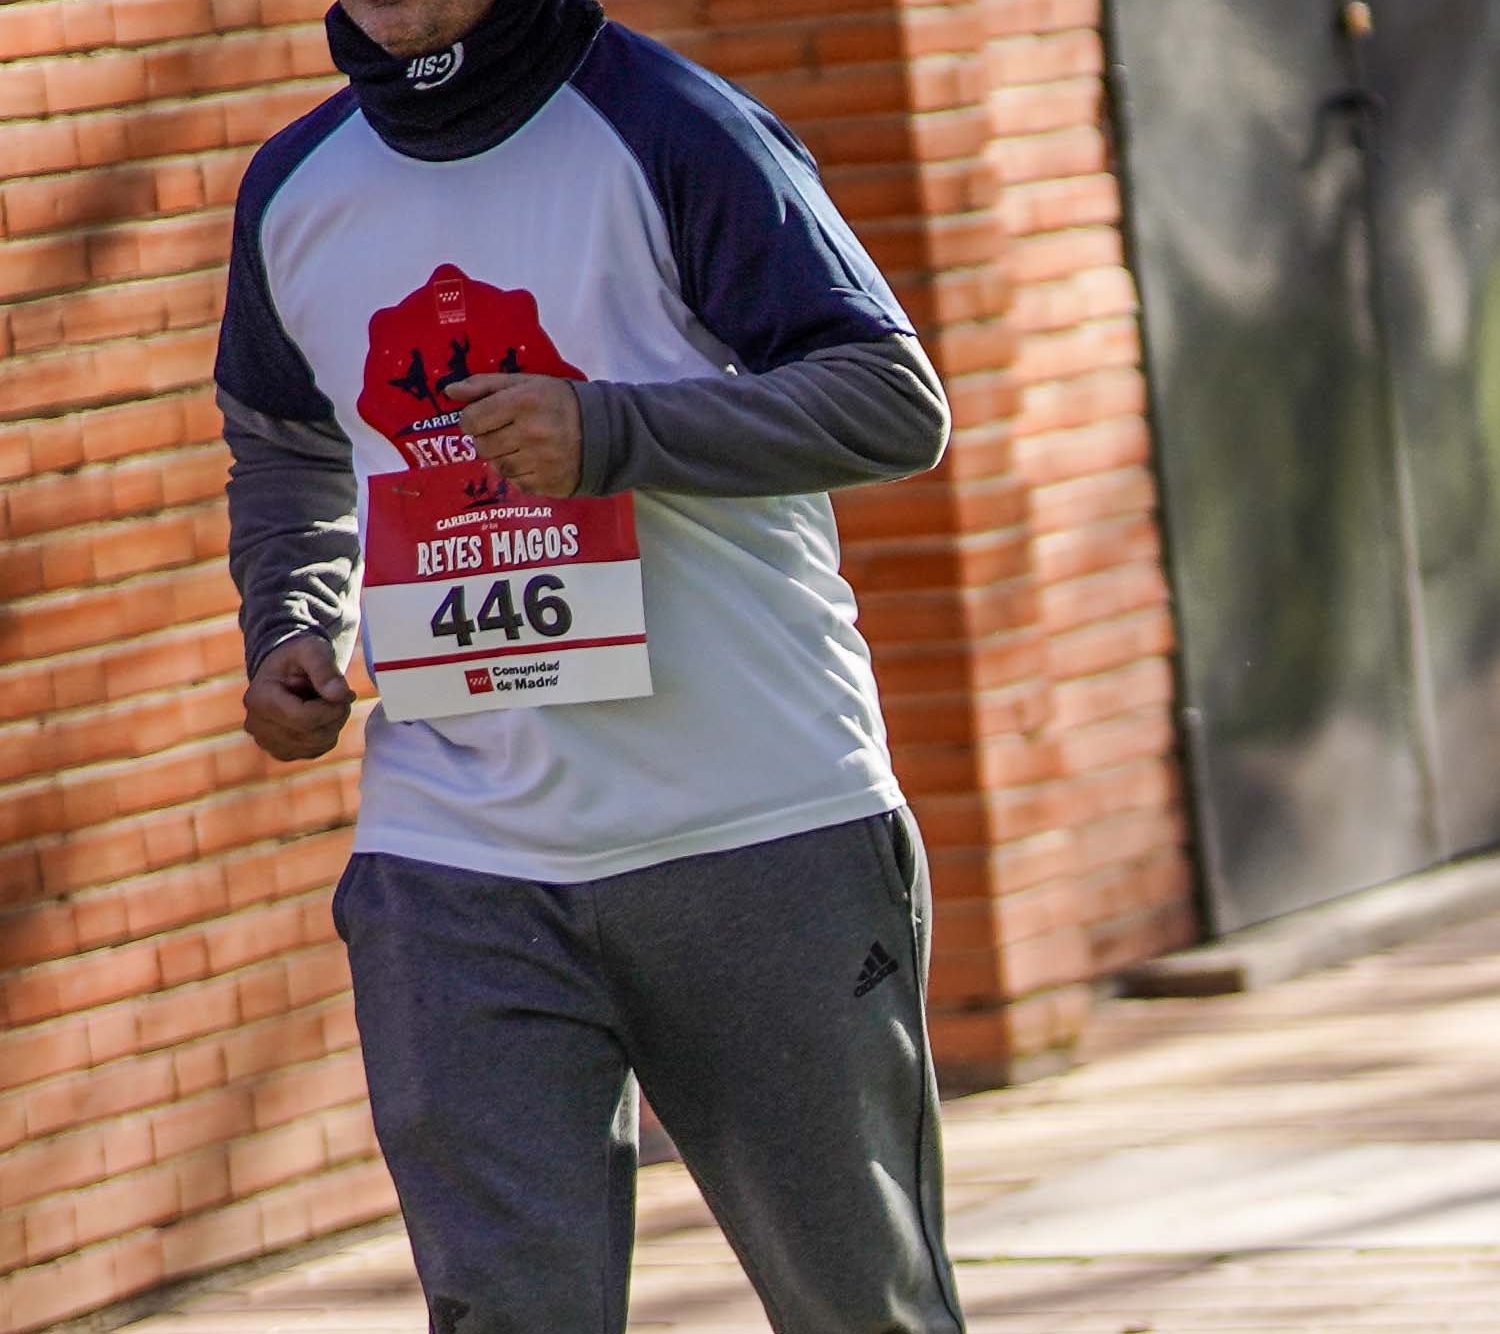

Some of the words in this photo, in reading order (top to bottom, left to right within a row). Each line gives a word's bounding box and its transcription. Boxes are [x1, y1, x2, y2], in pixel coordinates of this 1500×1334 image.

[407, 53, 451, 78] CSIF
[413, 411, 462, 431] CARRE
[436, 511, 488, 531] CARRERA
[490, 506, 552, 520] POPULAR
[417, 535, 482, 576] REYES
[490, 523, 579, 567] MAGOS
[431, 573, 573, 647] 446
[492, 660, 560, 677] Comunidad
[496, 680, 512, 692] de
[515, 675, 558, 691] Madrid
